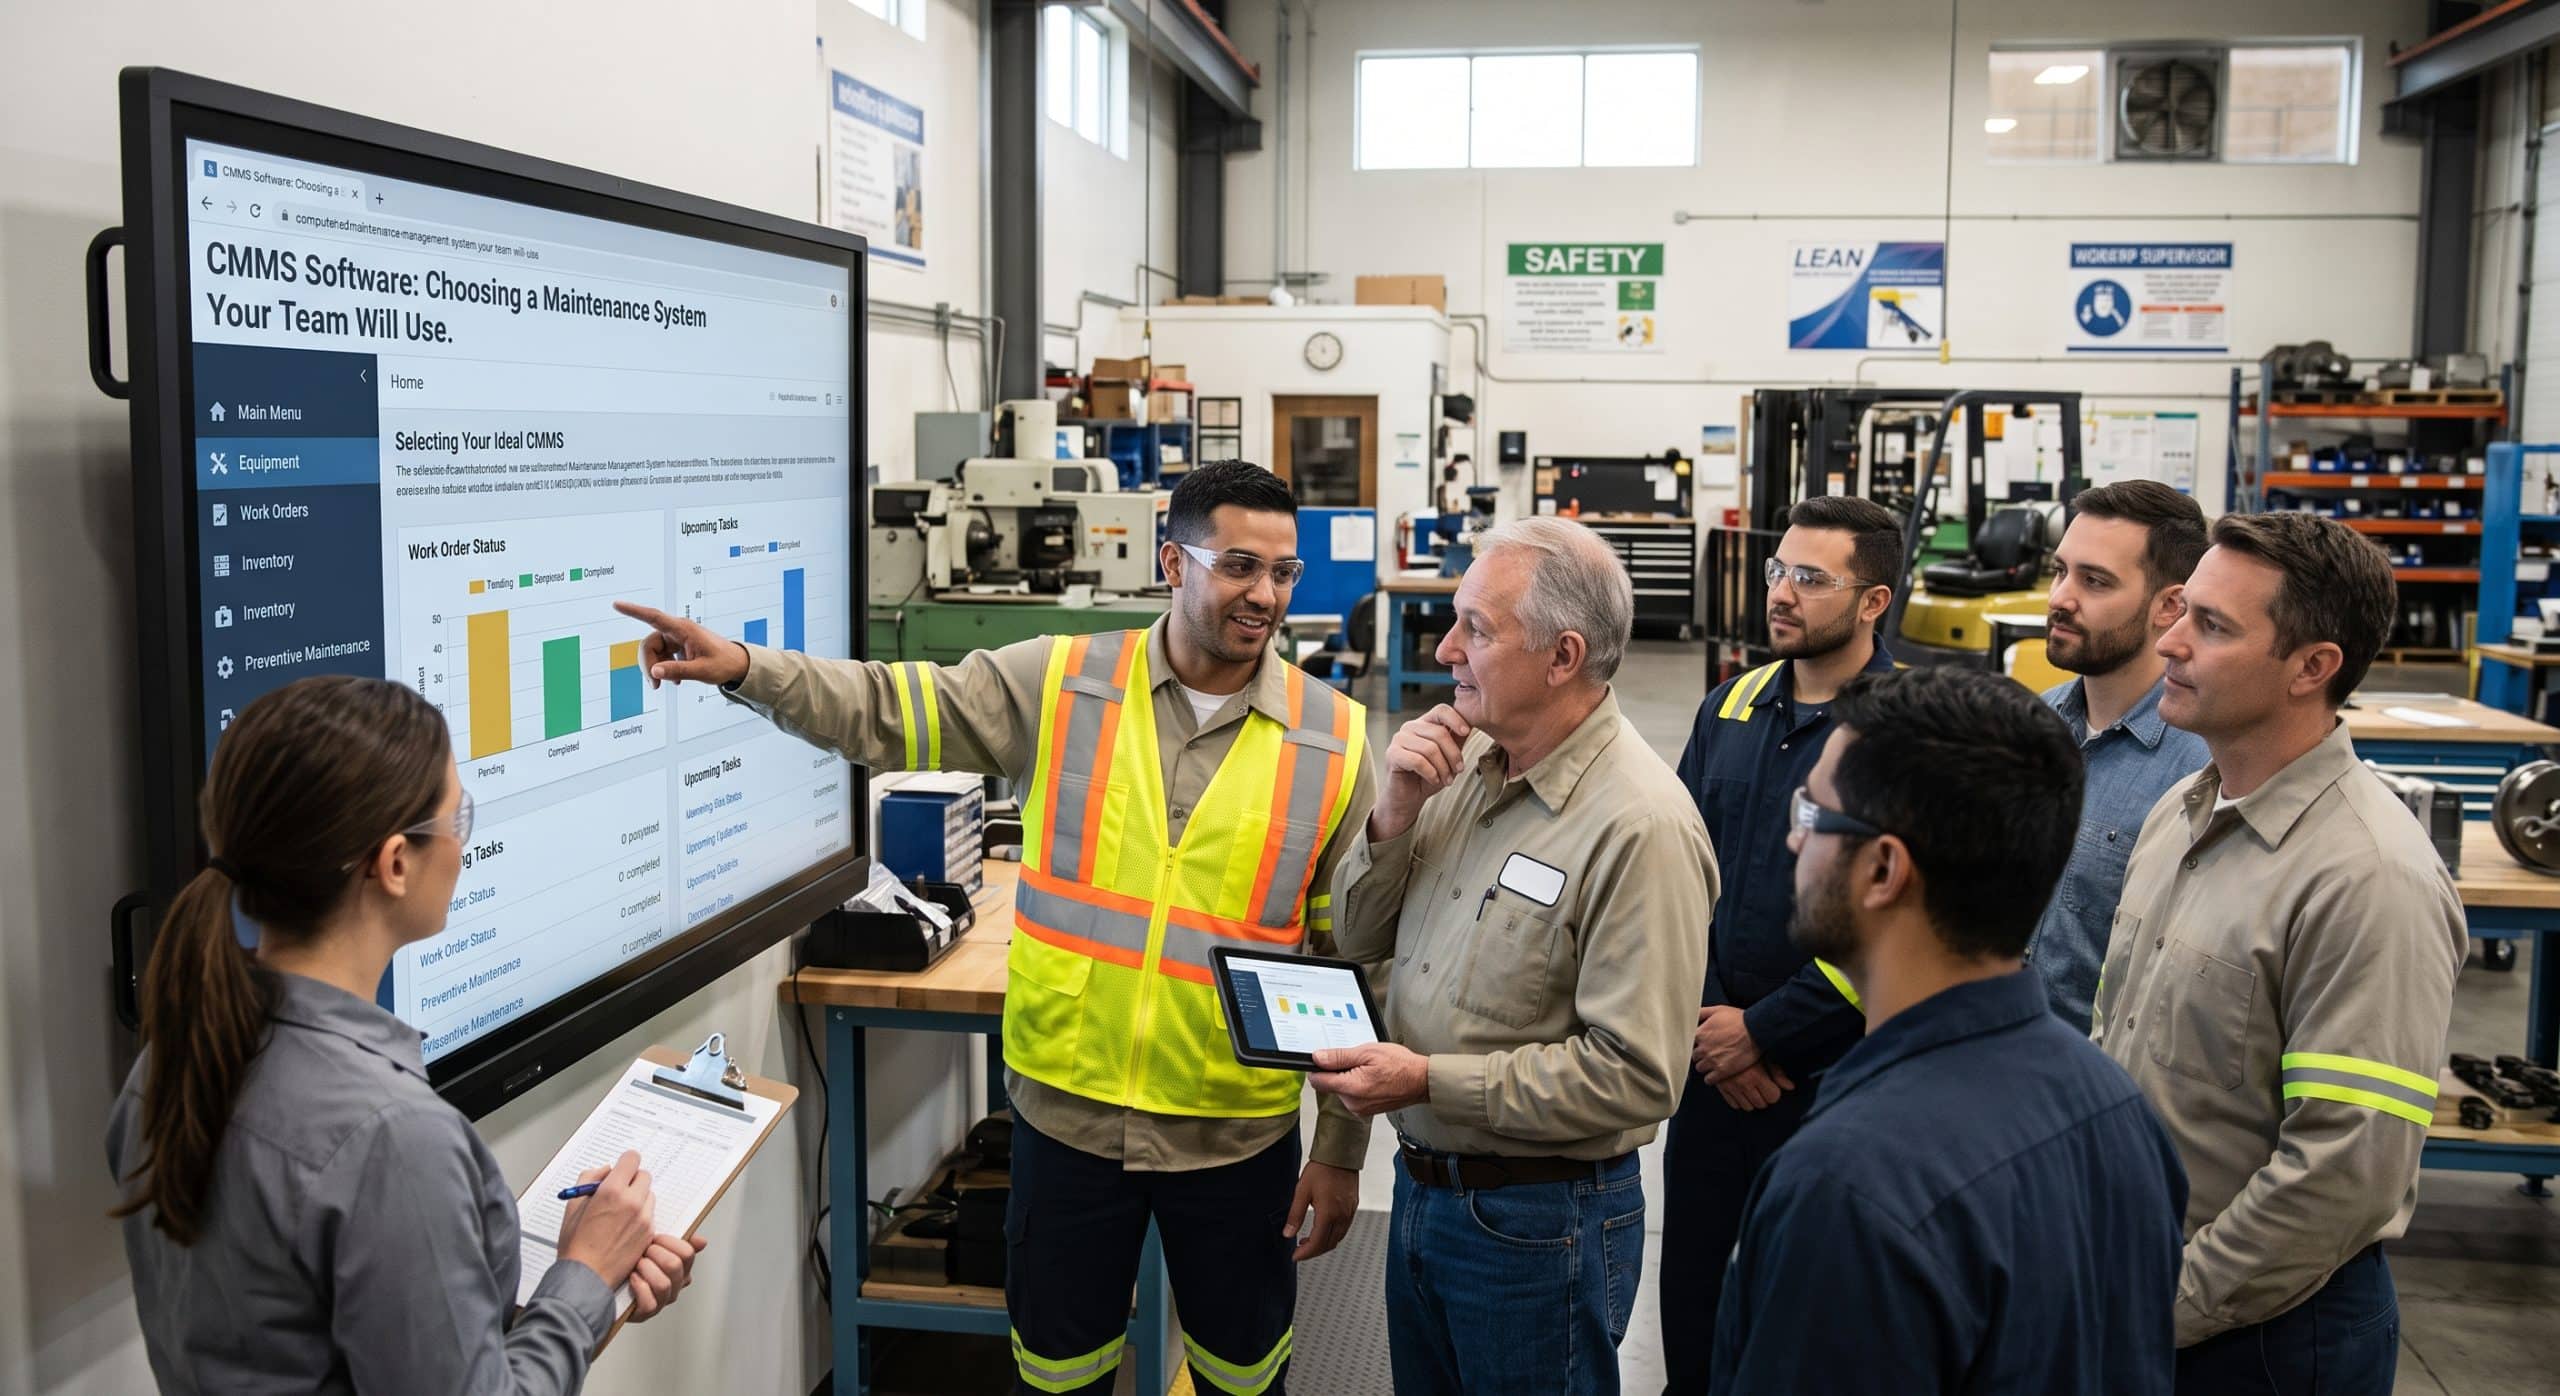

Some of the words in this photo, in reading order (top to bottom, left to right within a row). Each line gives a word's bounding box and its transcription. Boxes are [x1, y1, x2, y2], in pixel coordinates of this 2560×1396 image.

[222, 165, 251, 181] CMMS
[254, 171, 294, 188] Software:
[295, 178, 333, 197] Choosing
[1524, 247, 1647, 273] SAFETY
[1794, 248, 1864, 268] LEAN
[207, 241, 297, 283] CMMS
[305, 254, 419, 297] Software:
[425, 270, 521, 315] Choosing
[527, 289, 538, 310] a
[543, 285, 650, 322] Maintenance
[654, 300, 707, 330] System
[207, 292, 271, 329] Your
[279, 299, 348, 336] Team
[356, 307, 398, 339] Will
[405, 311, 453, 344] Use.
[391, 374, 424, 390] Home
[238, 404, 267, 420] Main
[270, 405, 302, 420] Menu
[395, 431, 459, 455] Selecting
[461, 431, 491, 450] Your
[494, 431, 523, 449] Ideal
[526, 431, 565, 449] CMMS
[239, 454, 300, 474] Equipment
[396, 465, 411, 477] The
[240, 504, 270, 521] Work
[272, 502, 309, 518] Orders
[681, 519, 717, 536] Upcoming
[717, 516, 738, 531] Tasks
[408, 543, 438, 560] Work
[440, 540, 471, 557] Order
[473, 538, 506, 555] Status
[242, 553, 294, 571] Inventory
[243, 602, 296, 621] Inventory
[432, 614, 442, 624] 50
[245, 649, 302, 672] Preventive
[305, 639, 371, 662] Maintenance
[433, 643, 442, 654] 40
[434, 673, 443, 684] 30
[478, 763, 505, 778] Pending
[685, 763, 721, 787] Upcoming
[721, 756, 742, 773] Tasks
[474, 840, 504, 862] Tasks
[448, 893, 468, 914] rder
[468, 886, 496, 904] Status
[420, 950, 443, 969] Work
[445, 939, 469, 959] Order
[470, 926, 497, 946] Status
[421, 979, 468, 1012] Preventive
[468, 957, 521, 990] Maintenance
[471, 996, 524, 1034] Maintenance
